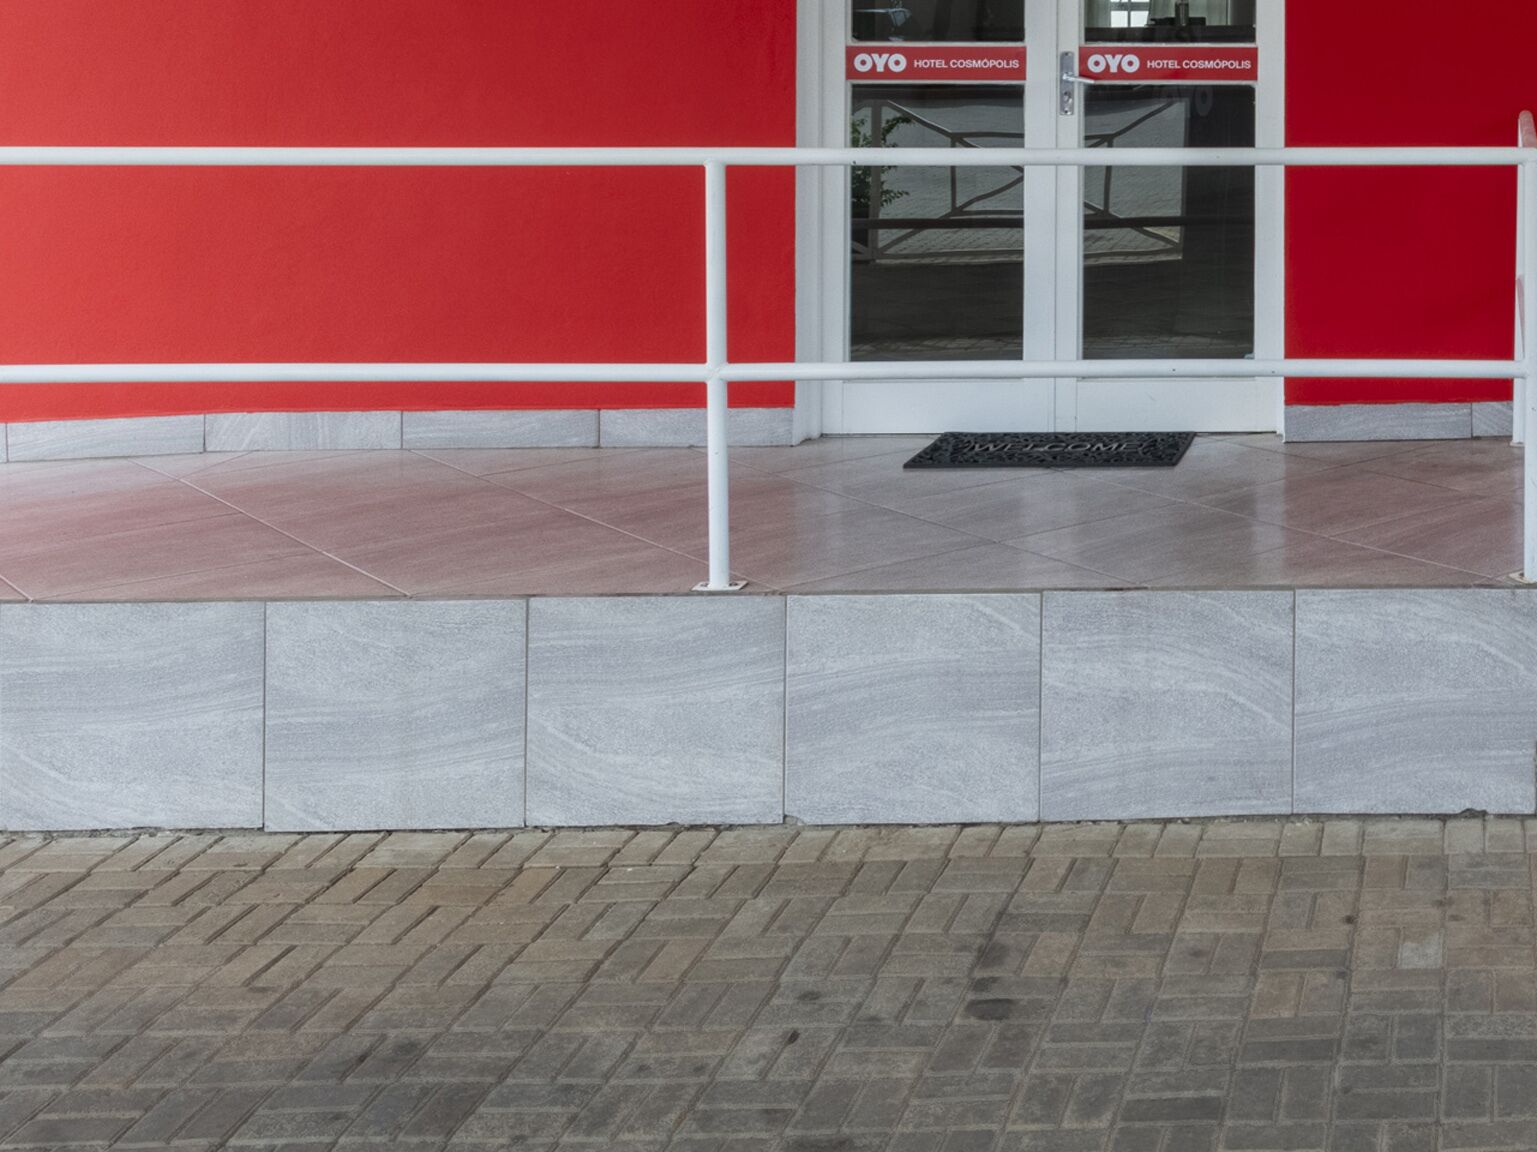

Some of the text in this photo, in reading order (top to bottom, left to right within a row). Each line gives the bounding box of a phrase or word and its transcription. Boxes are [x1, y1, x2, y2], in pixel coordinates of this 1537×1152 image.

[853, 53, 1020, 73] OYO HOTEL COSMÓPOLIS
[1087, 53, 1252, 73] OYO HOTEL COSMÓPOLIS
[973, 442, 1139, 452] WELCOME
